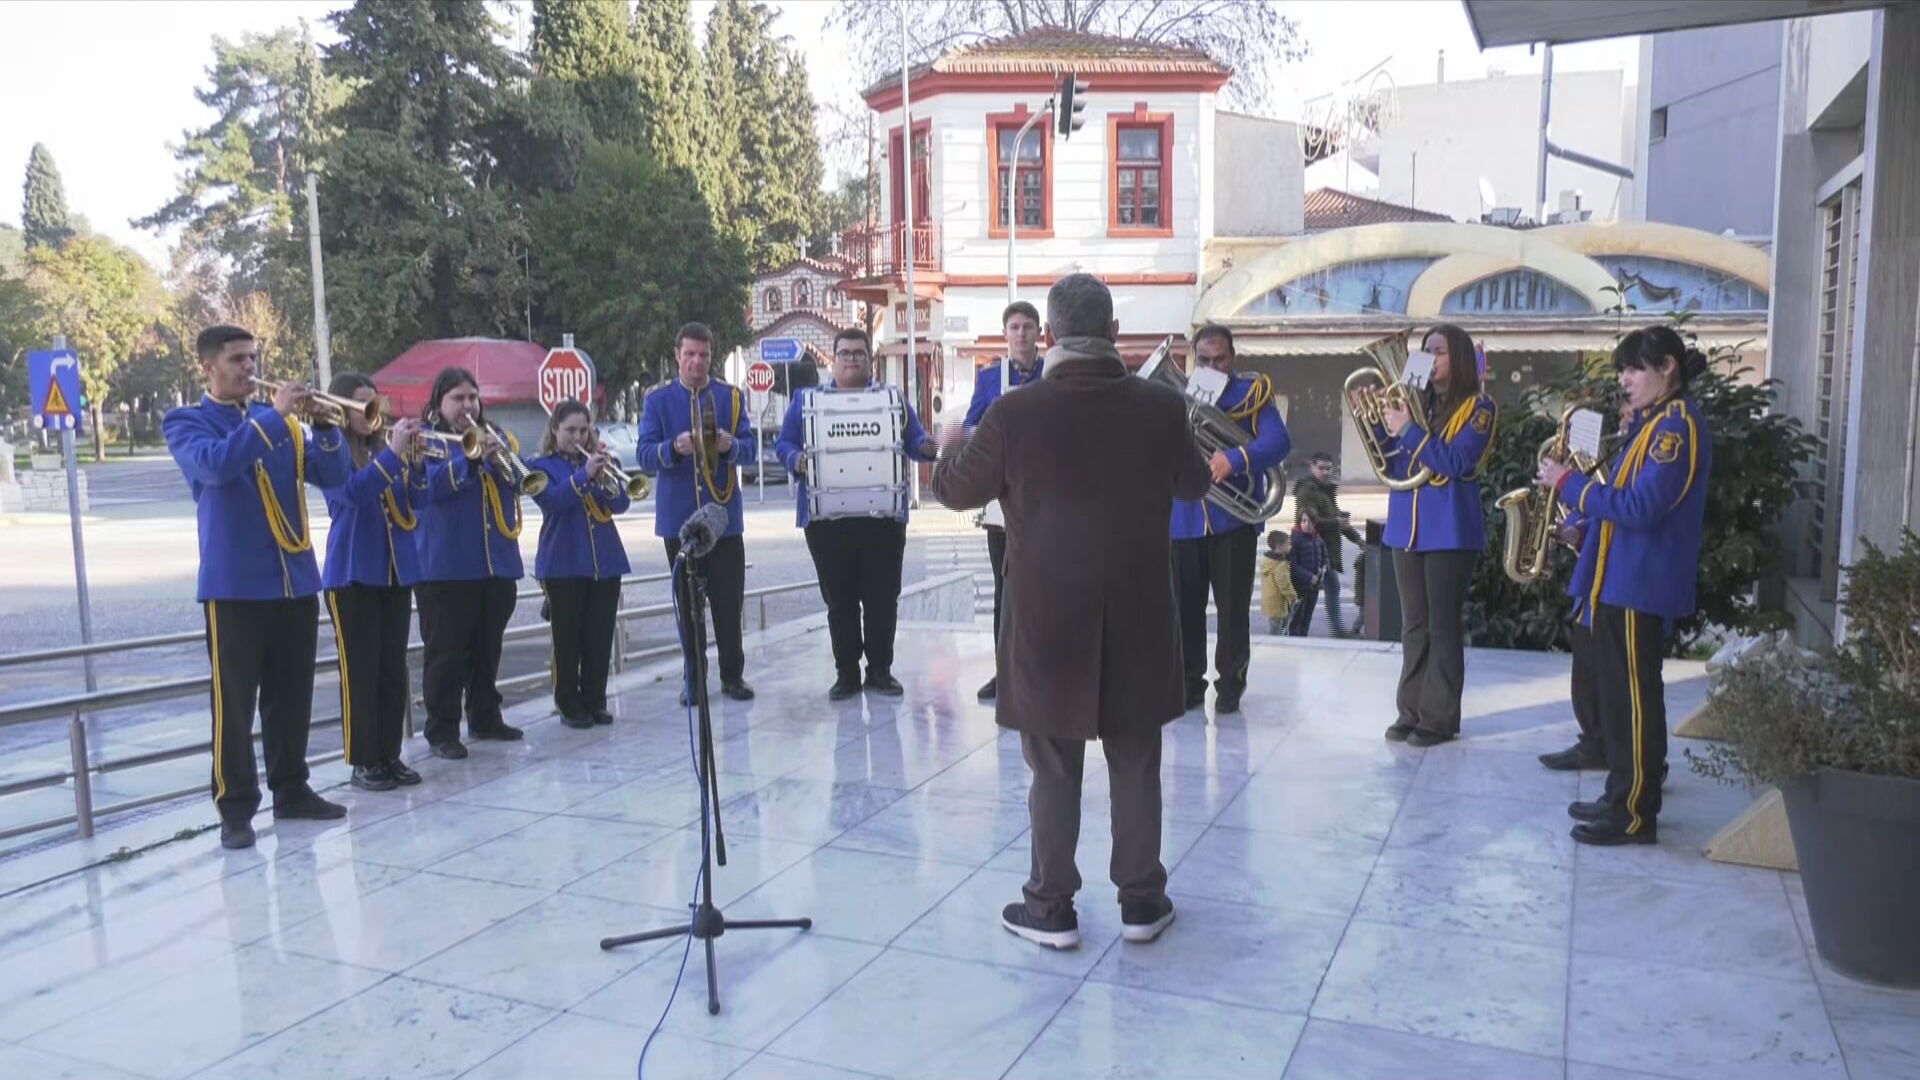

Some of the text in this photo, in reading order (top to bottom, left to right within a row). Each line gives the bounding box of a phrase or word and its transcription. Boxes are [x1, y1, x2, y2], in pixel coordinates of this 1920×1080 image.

[543, 367, 586, 403] STOP
[748, 369, 772, 386] STOP
[827, 422, 881, 438] JINDAO
